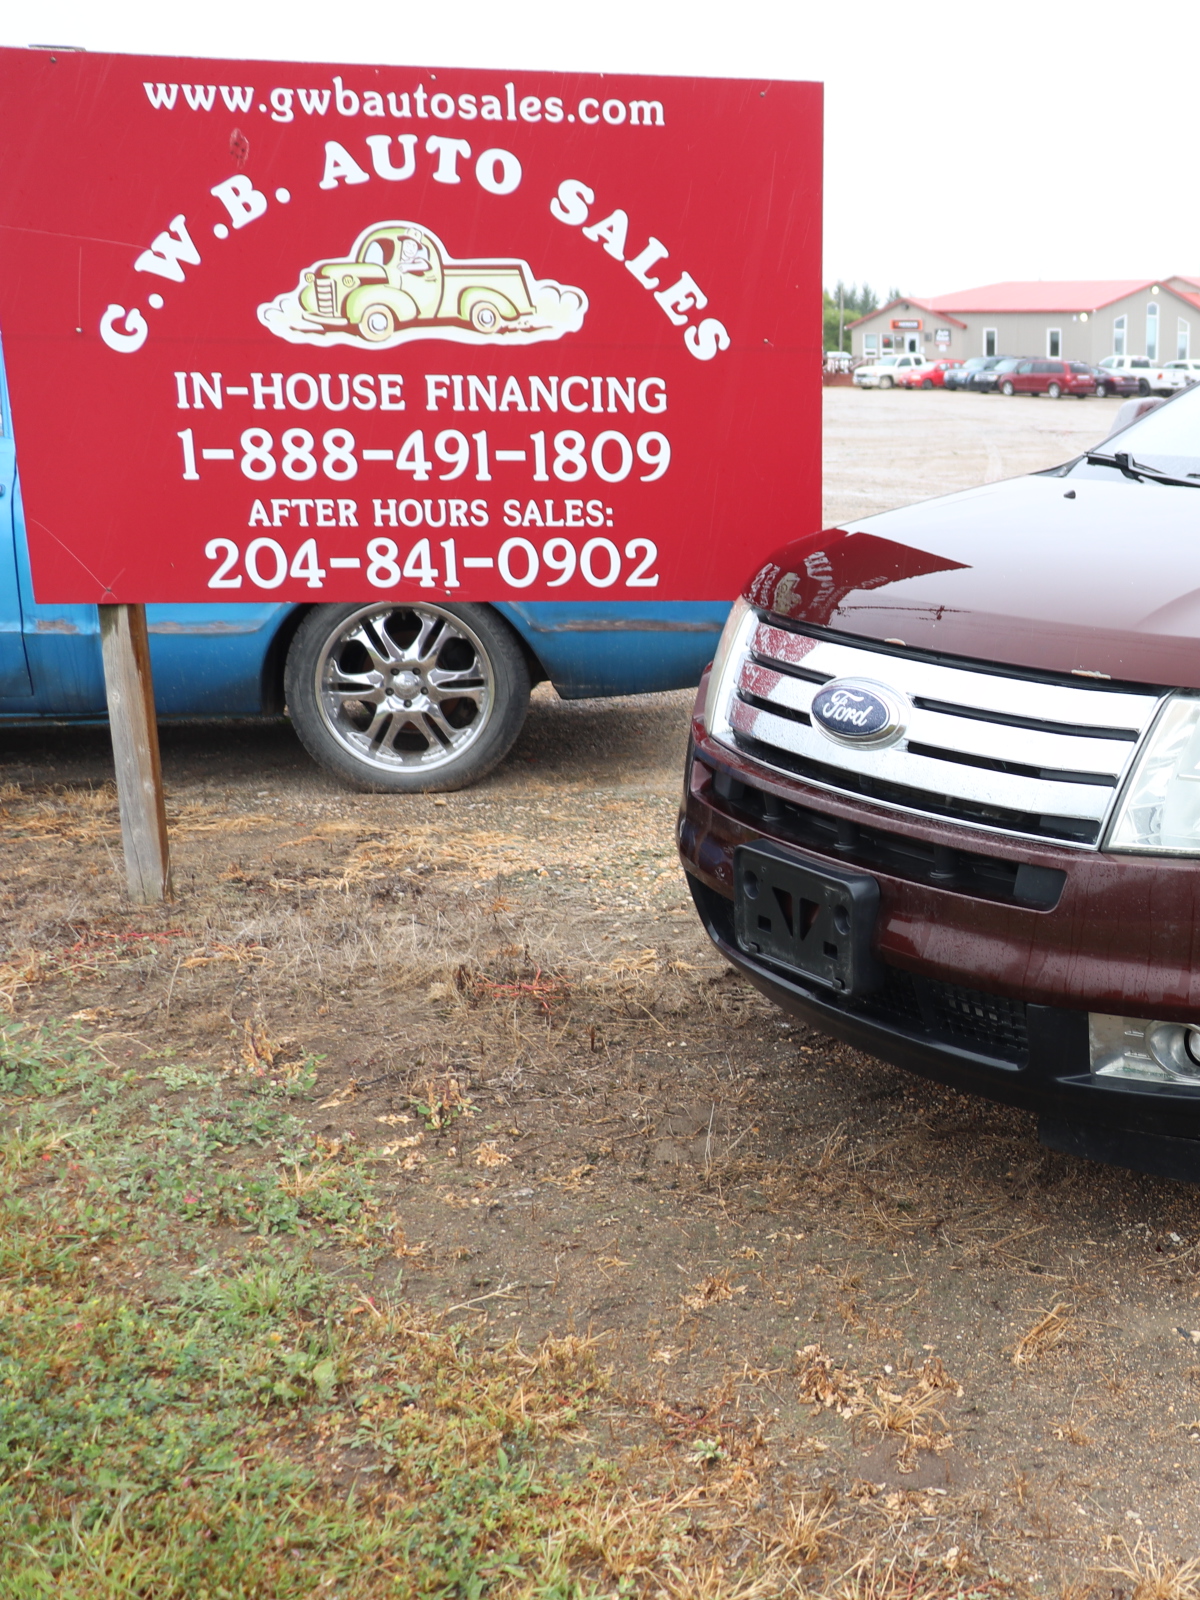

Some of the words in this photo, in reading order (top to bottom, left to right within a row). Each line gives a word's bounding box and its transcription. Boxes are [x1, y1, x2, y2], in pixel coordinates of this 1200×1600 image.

[142, 75, 666, 127] www.gwbautosales.com
[99, 174, 291, 354] G.W.B.
[318, 133, 523, 196] AUTO
[549, 178, 731, 361] SALES
[173, 371, 406, 412] IN-HOUSE
[424, 374, 668, 415] FINANCING
[176, 427, 671, 483] 1-888-491-1809
[247, 498, 359, 527] AFTER
[371, 498, 490, 528] HOURS
[503, 498, 613, 528] SALES:
[204, 536, 660, 590] 204-841-0902
[822, 690, 873, 727] Ford
